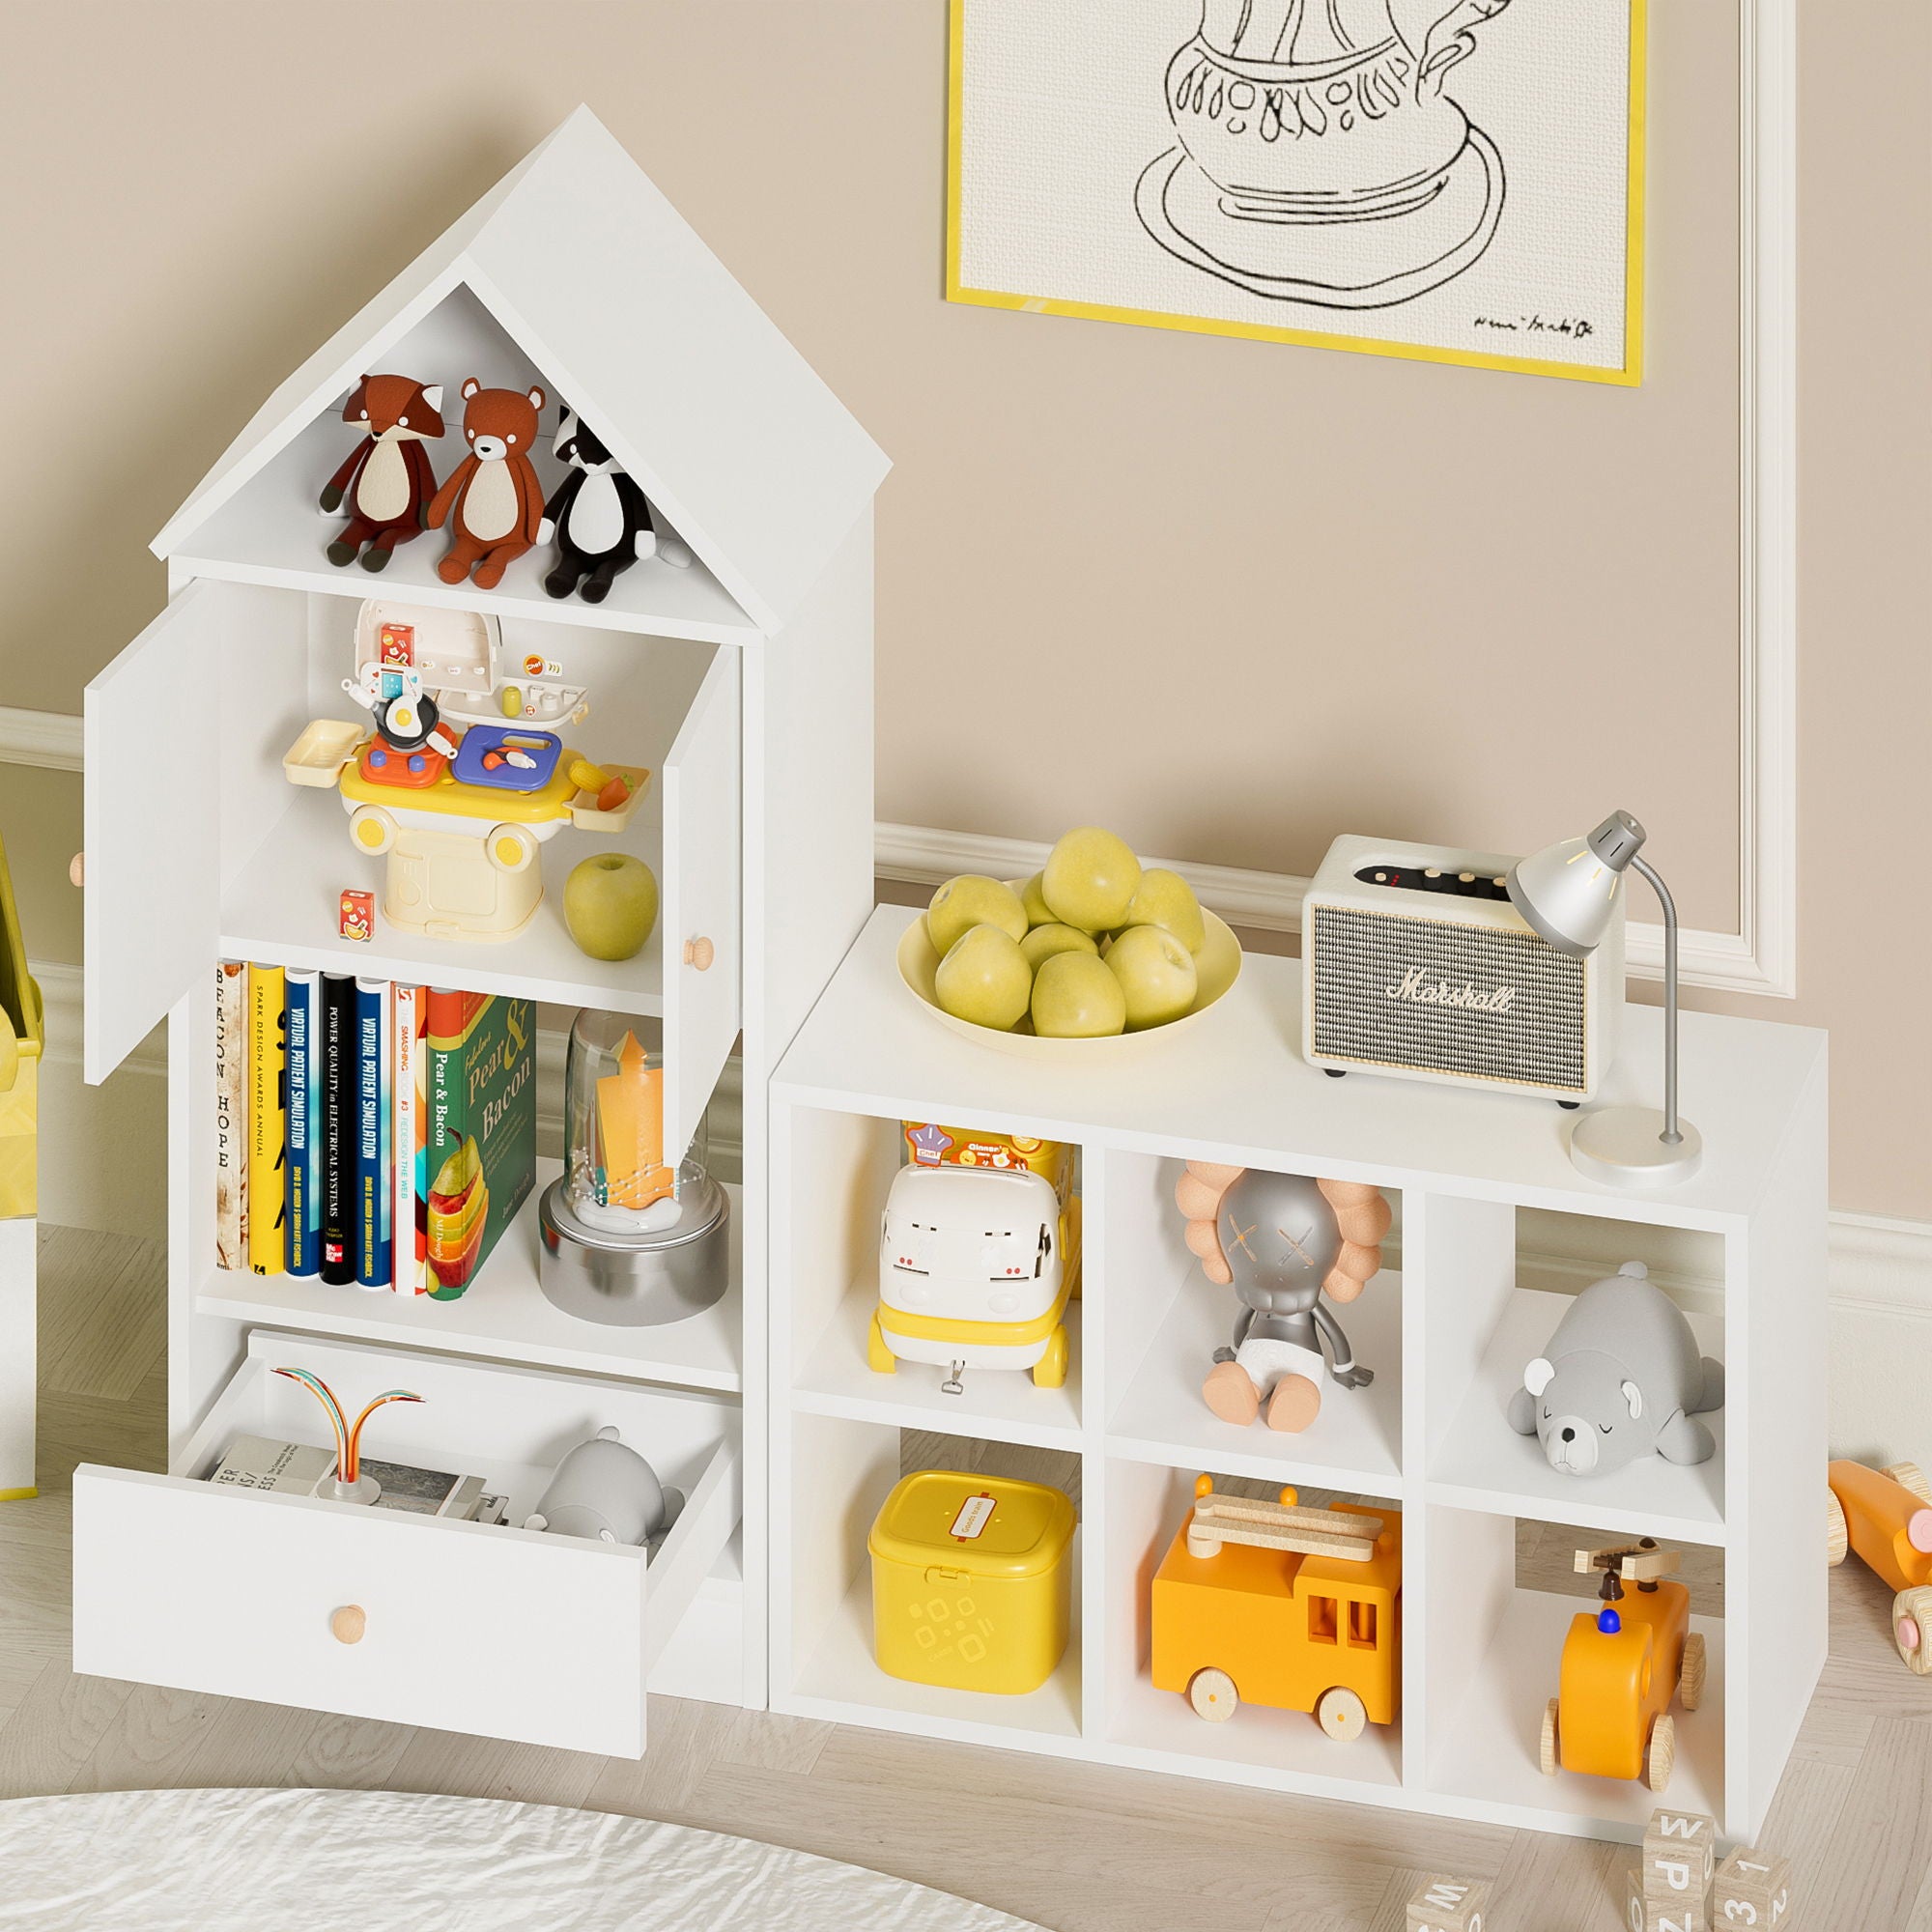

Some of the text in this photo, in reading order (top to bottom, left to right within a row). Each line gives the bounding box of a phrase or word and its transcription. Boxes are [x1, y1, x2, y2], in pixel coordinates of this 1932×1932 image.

[1386, 966, 1516, 1013] Marshall
[329, 1007, 338, 1042] POWER
[504, 999, 529, 1071] &
[292, 1008, 305, 1150] VIRTUAL PATIENT SIMULATION
[328, 1045, 338, 1093] QUALITY
[362, 1017, 377, 1160] VIRTUAL PATIENT SIMULATION
[469, 1038, 504, 1110] Pear
[329, 1094, 338, 1102] in
[401, 1100, 409, 1112] #3
[436, 1053, 448, 1147] Pear & Bacon
[482, 1056, 531, 1145] Bacon
[218, 1095, 230, 1168] HOPE
[329, 1104, 338, 1169] ELECTRICAL
[329, 1170, 338, 1217] SYSTEMS
[1654, 1860, 1690, 1890] P
[1723, 1898, 1757, 1925] 3
